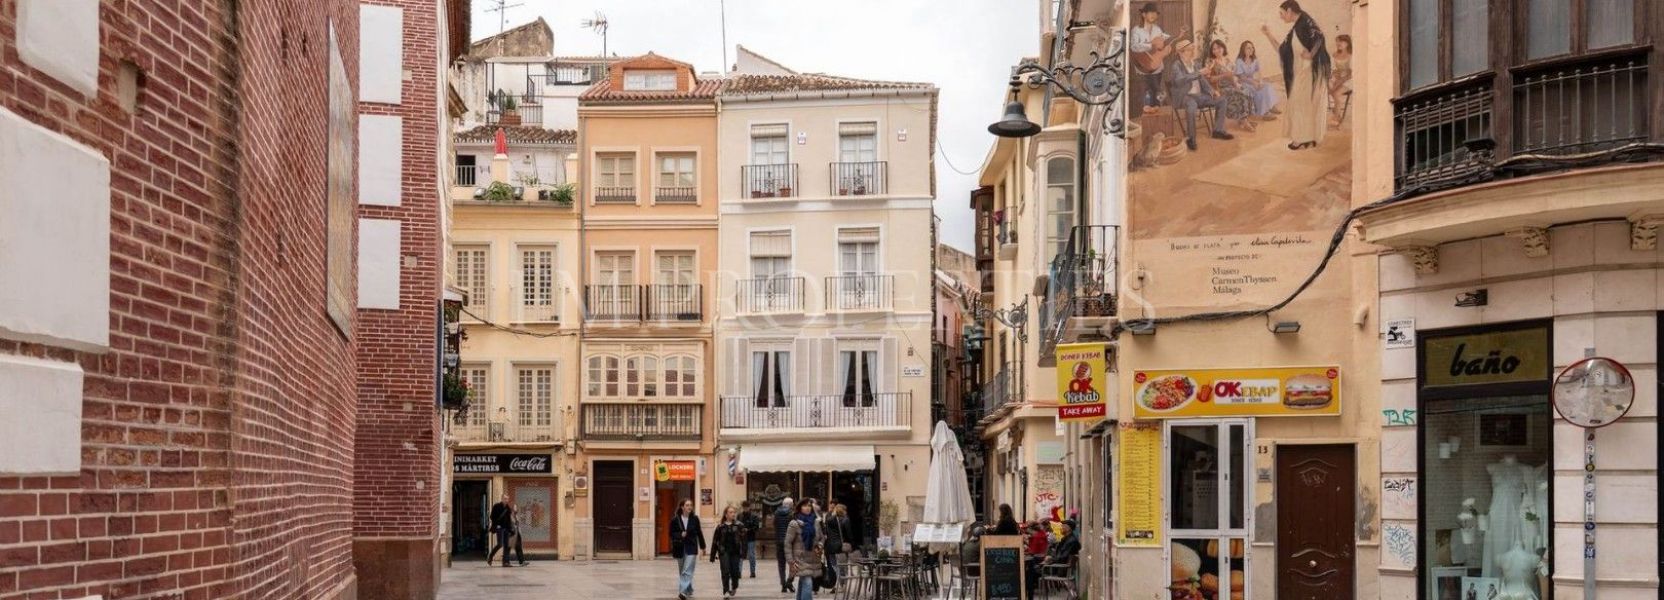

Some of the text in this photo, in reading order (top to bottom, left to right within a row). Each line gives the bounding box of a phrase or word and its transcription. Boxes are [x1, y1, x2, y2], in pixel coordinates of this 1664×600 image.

[1212, 267, 1240, 275] Museo
[1212, 286, 1242, 295] Málaga
[1450, 343, 1521, 376] baño
[1069, 377, 1094, 392] OK
[1064, 390, 1099, 403] Kebab
[1082, 406, 1102, 414] AWAY
[1258, 445, 1268, 454] 13
[461, 463, 500, 472] MÁRTIRES
